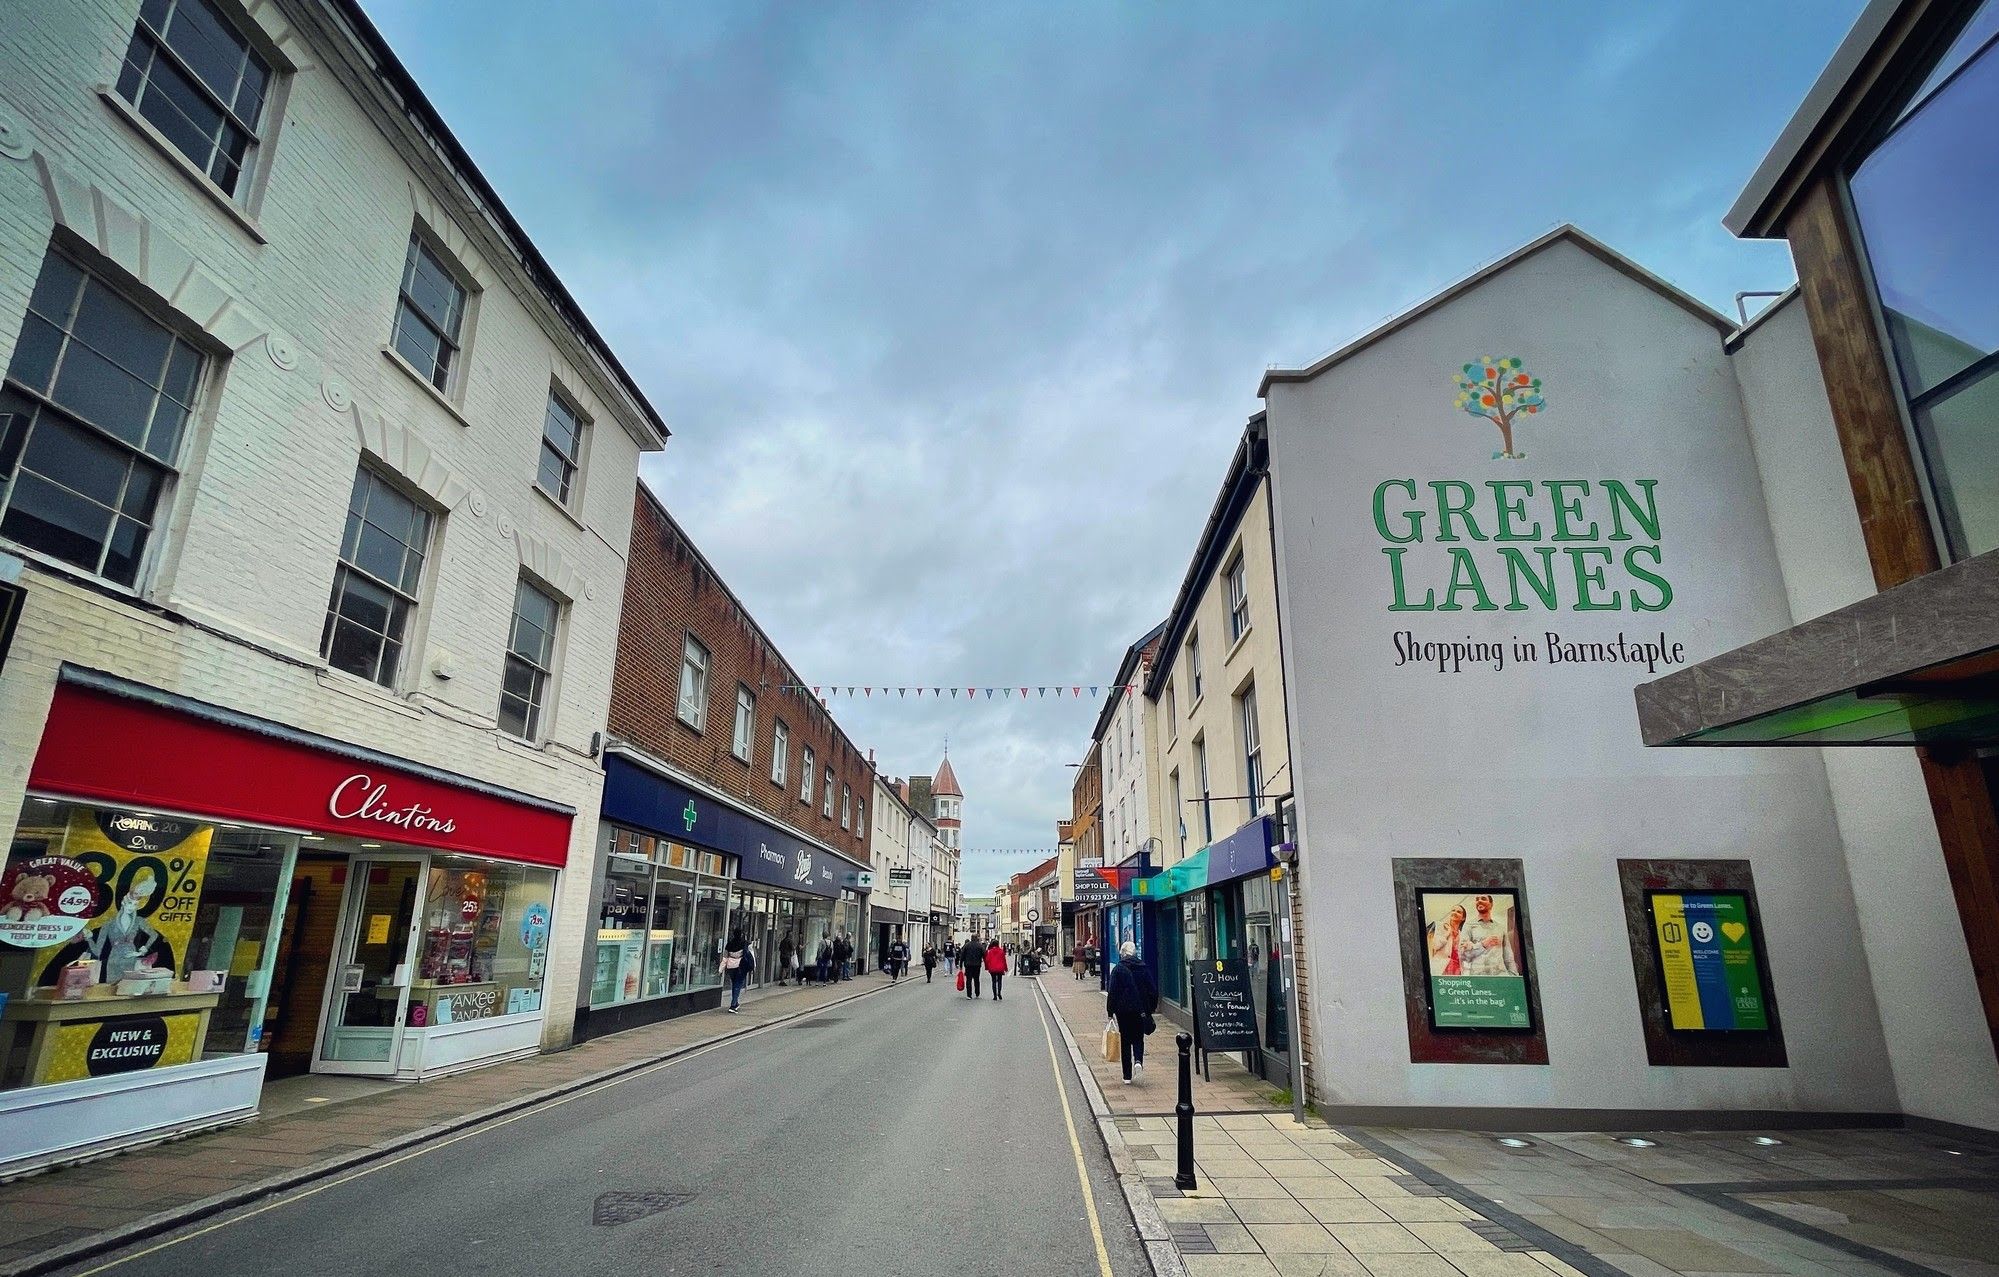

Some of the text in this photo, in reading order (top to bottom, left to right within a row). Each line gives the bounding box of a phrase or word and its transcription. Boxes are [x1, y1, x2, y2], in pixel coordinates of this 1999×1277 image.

[1372, 478, 1661, 543] GREEN
[1382, 545, 1674, 612] LANES
[1393, 631, 1685, 673] Shopping in Barnstaple
[329, 774, 456, 833] Clintons
[110, 814, 159, 831] ROARING
[760, 842, 786, 869] Pharmacy
[29, 857, 86, 873] GREAT VALUE
[60, 896, 90, 907] £4.99
[163, 896, 196, 911] OFF
[607, 904, 629, 915] pay
[159, 912, 193, 922] GIFTS
[37, 924, 61, 932] DRESS
[38, 933, 57, 941] BEAR
[1201, 973, 1239, 984] 22 Hour
[1438, 979, 1472, 988] Shopping
[1208, 987, 1243, 1002] Vacancy
[1448, 988, 1470, 996] Green
[1467, 997, 1475, 1005] in
[1476, 997, 1488, 1005] the
[1489, 997, 1505, 1008] bag!
[109, 1029, 152, 1042] NEW &
[91, 1044, 161, 1060] EXCLUSIVE
